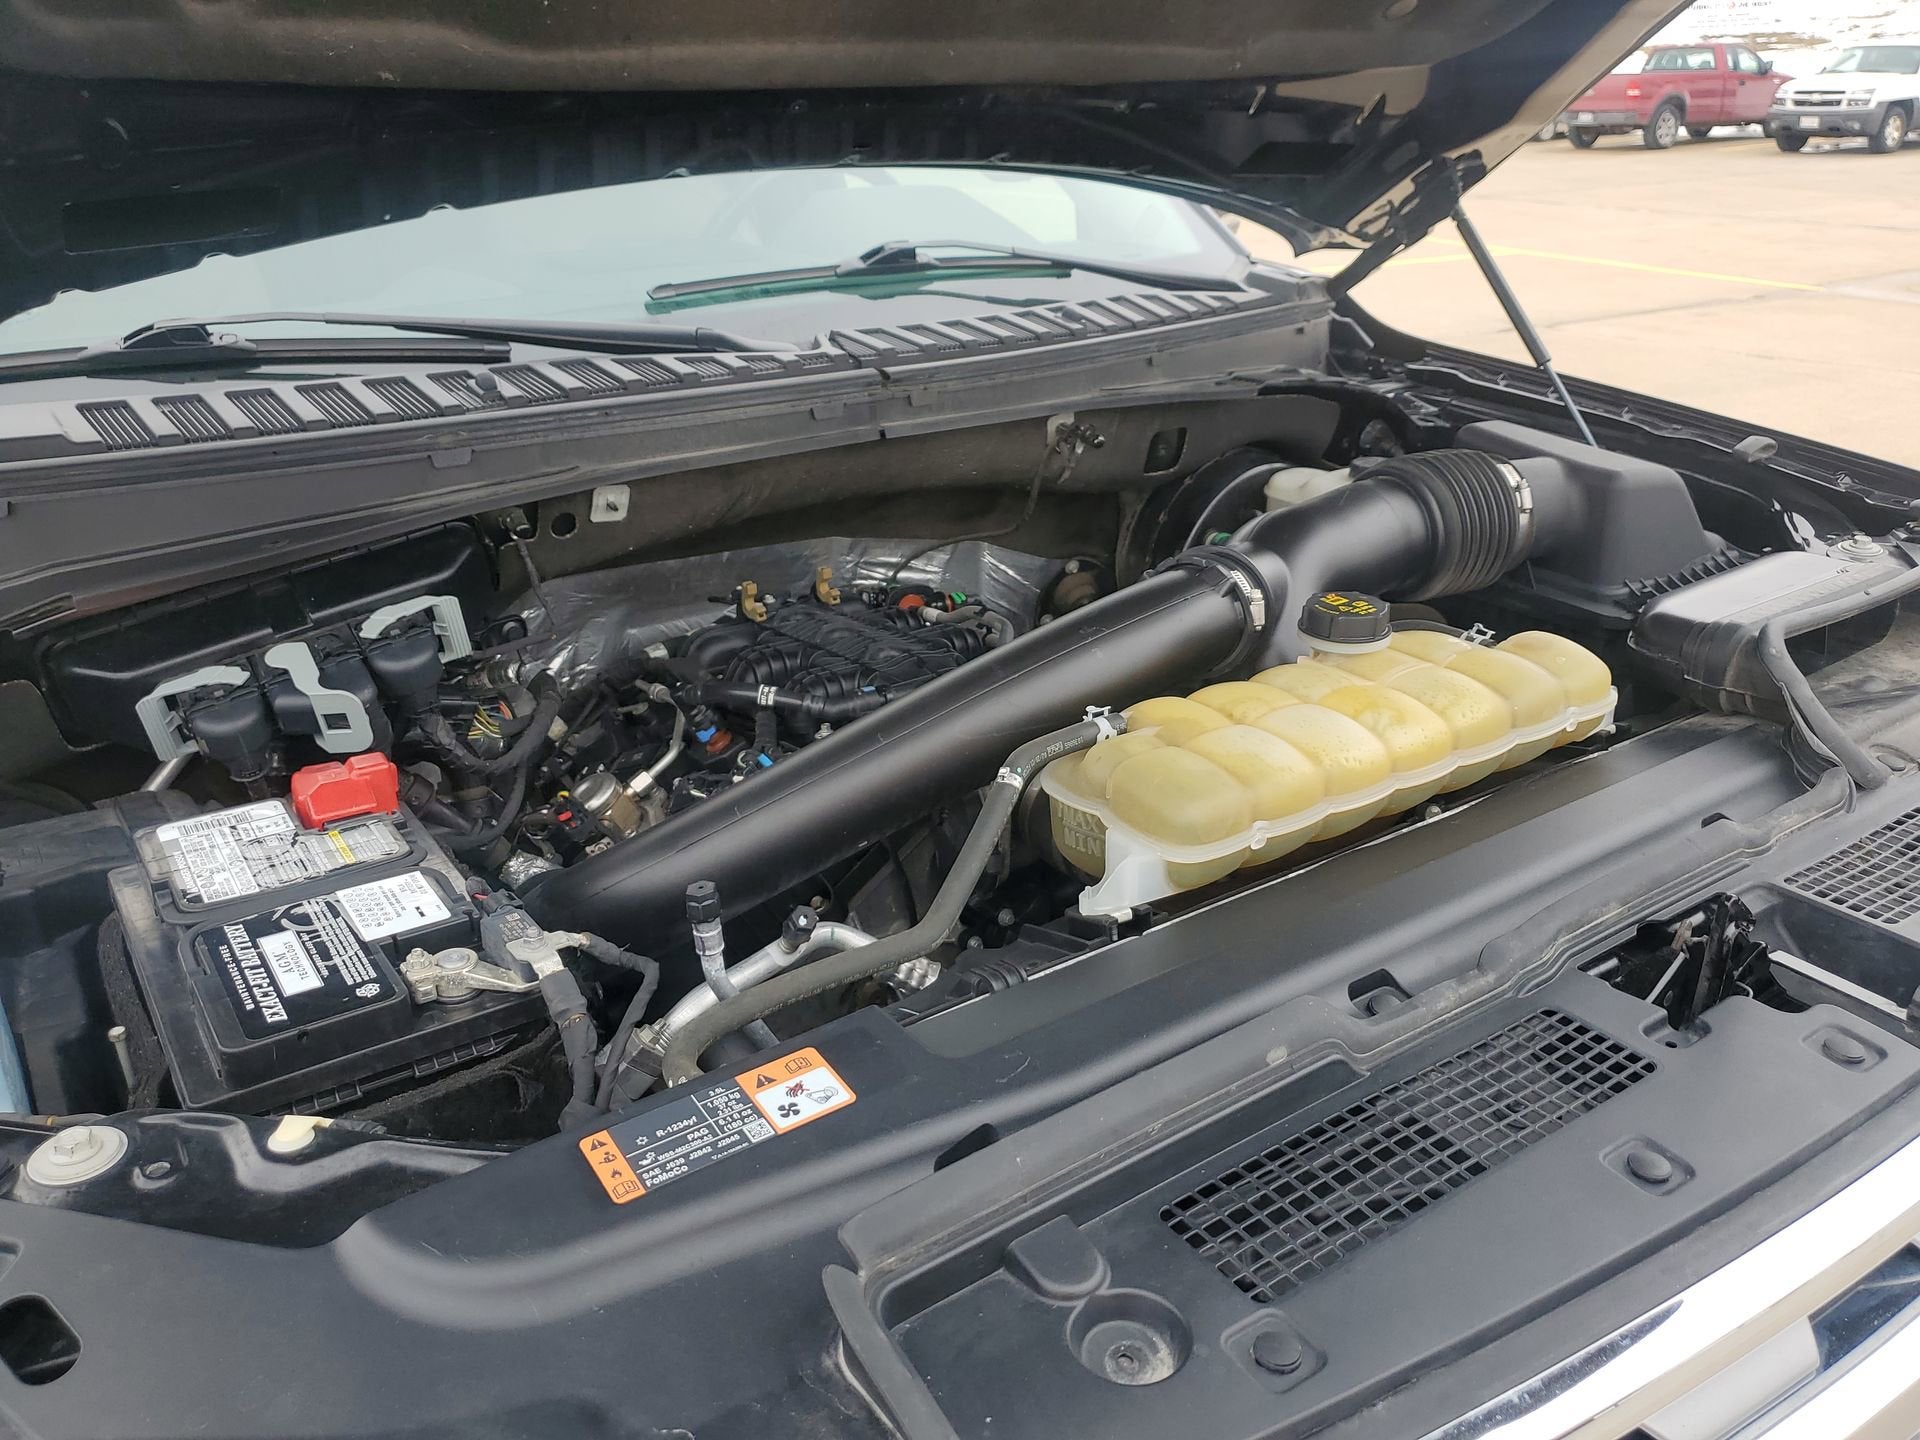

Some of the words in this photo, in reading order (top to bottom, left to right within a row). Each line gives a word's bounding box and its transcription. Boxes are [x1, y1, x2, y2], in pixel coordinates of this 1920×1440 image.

[1064, 826, 1101, 857] MIN
[223, 924, 262, 968] BATTERY
[283, 941, 309, 980] TECHNOLOGY
[728, 1091, 741, 1101] kg
[732, 1103, 744, 1112] lbs
[656, 1115, 697, 1138] R-1234yf
[744, 1114, 758, 1123] cc)
[687, 1127, 709, 1141] PAG
[642, 1167, 662, 1180] SAE
[644, 1165, 689, 1188] FoMoCo
